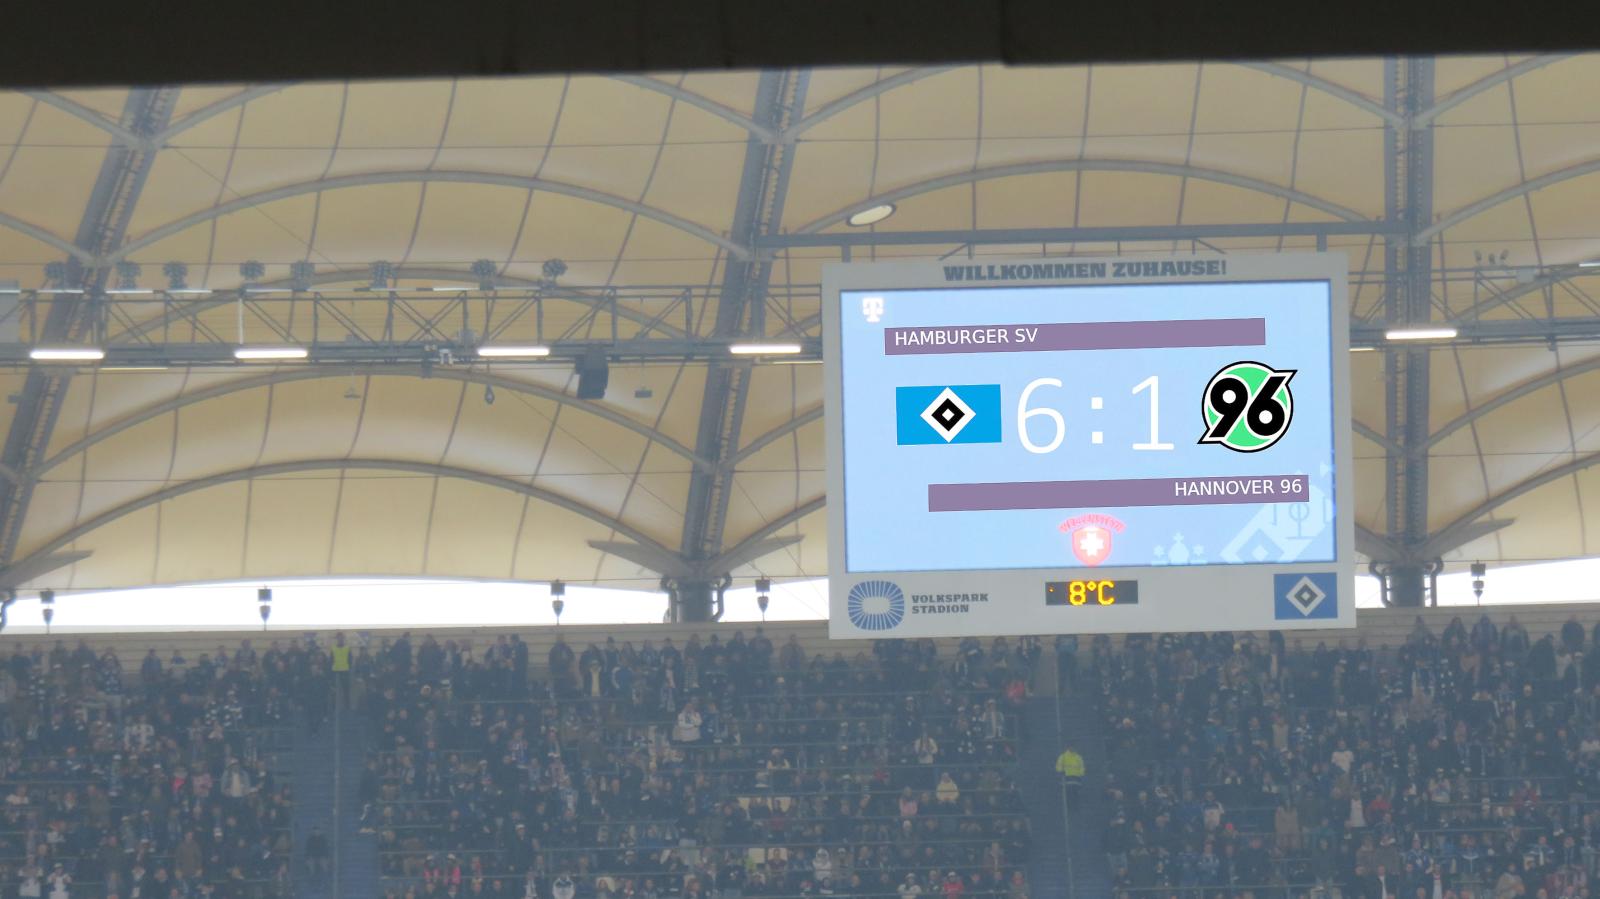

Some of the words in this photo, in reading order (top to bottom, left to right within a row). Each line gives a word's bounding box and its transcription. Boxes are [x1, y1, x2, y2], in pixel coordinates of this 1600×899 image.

[943, 262, 1106, 281] WILLKOMMEN
[1112, 260, 1227, 278] ZUHAUSE!
[895, 329, 1009, 346] HAMBURGER
[1015, 328, 1038, 343] SV
[1208, 376, 1288, 438] 96
[1174, 480, 1274, 496] HANNOVER
[1280, 479, 1302, 493] 96
[911, 593, 989, 604] VOLKSPARK
[1069, 580, 1115, 606] 8°C
[911, 604, 970, 614] STADION
